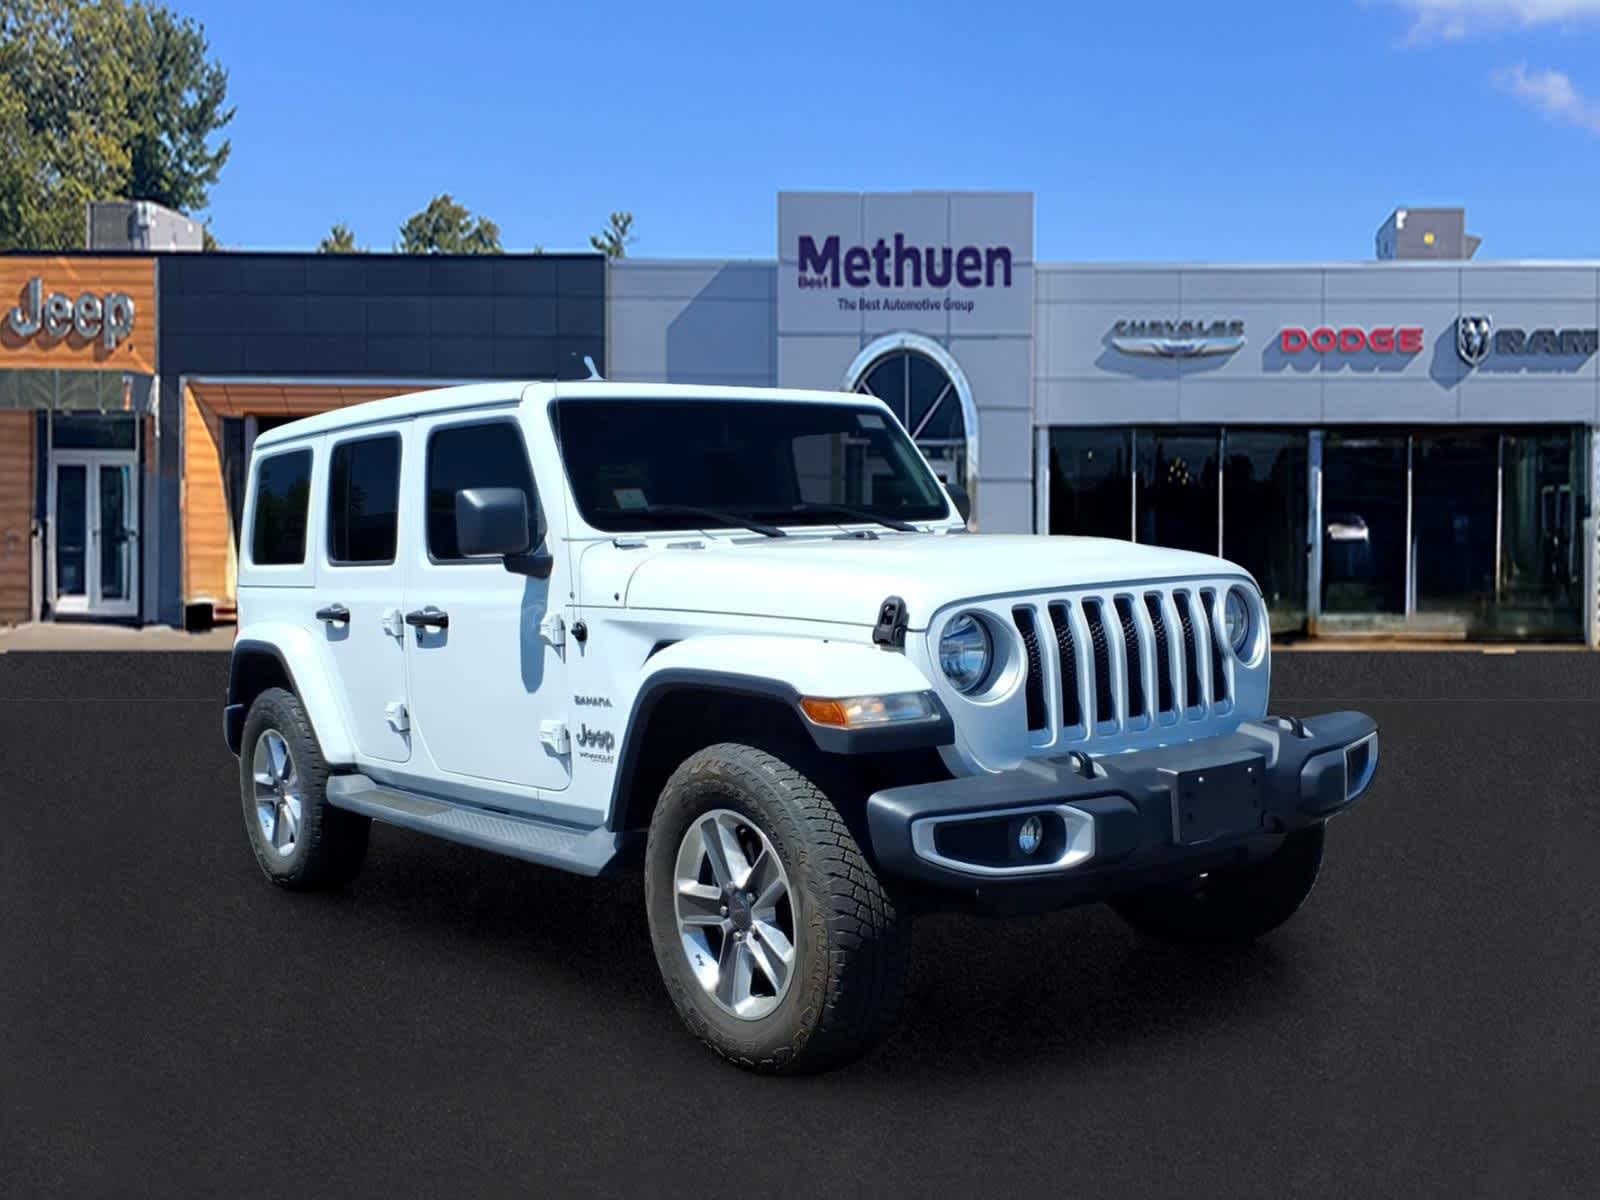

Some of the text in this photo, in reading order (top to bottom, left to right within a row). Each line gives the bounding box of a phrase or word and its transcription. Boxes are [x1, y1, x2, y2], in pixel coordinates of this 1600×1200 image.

[798, 233, 1012, 288] Methuen
[9, 276, 135, 350] Jeep
[838, 297, 974, 314] The Best Automotive Group
[1114, 320, 1244, 336] CHRYSLER
[1281, 327, 1423, 353] DODGE
[1495, 329, 1598, 354] RAM
[576, 723, 615, 753] Jeep
